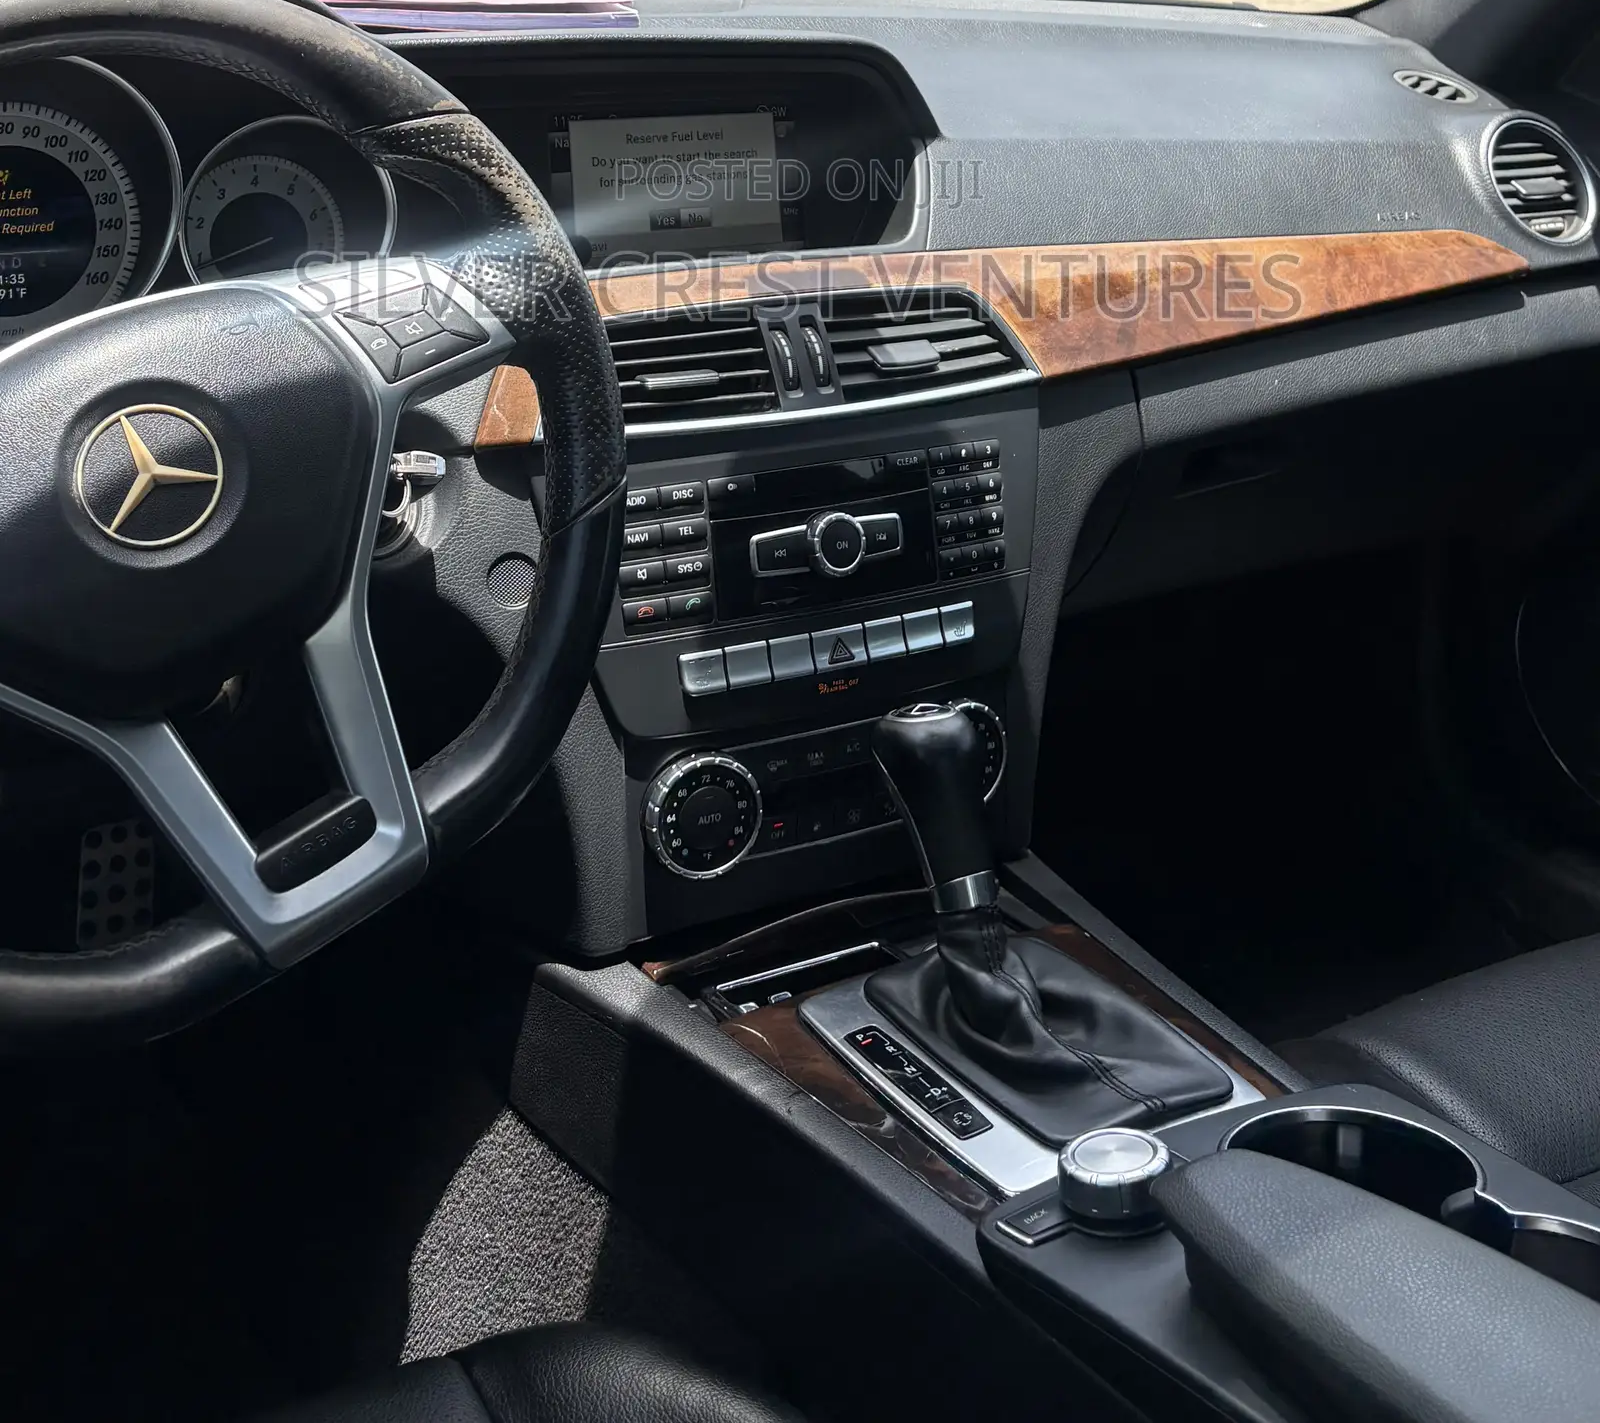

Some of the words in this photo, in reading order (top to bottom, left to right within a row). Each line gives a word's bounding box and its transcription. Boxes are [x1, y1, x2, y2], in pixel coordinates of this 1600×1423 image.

[22, 126, 40, 139] 90
[626, 133, 669, 145] Reserve
[671, 130, 693, 142] Fuel
[697, 129, 724, 140] Level
[44, 135, 68, 148] 100
[67, 150, 89, 163] 110
[592, 156, 606, 167] Do
[610, 155, 630, 170] you
[633, 155, 659, 166] want
[662, 153, 674, 164] to
[676, 151, 700, 163] start
[704, 149, 721, 160] the
[724, 148, 757, 159] search
[83, 169, 107, 182] 120
[599, 177, 615, 188] for
[685, 173, 703, 185] gas
[250, 176, 259, 187] 4
[9, 189, 32, 200] Left
[217, 189, 226, 200] 3
[287, 184, 295, 195] 5
[94, 192, 118, 206] 130
[310, 209, 317, 221] 6
[656, 214, 675, 225] Yes
[688, 212, 703, 223] No
[2, 221, 55, 235] Required
[98, 217, 123, 231] 140
[195, 217, 205, 229] 2
[95, 244, 120, 258] 150
[85, 271, 110, 286] 160
[986, 445, 991, 454] 3
[897, 457, 918, 466] CLEAR
[989, 478, 994, 488] 6
[673, 489, 694, 500] DISC
[626, 495, 647, 507] ADIO
[968, 516, 974, 525] 8
[991, 511, 997, 521] 9
[945, 520, 951, 530] 7
[678, 526, 694, 536] TEL
[627, 533, 649, 544] NAVI
[836, 541, 849, 550] ON
[972, 550, 977, 559] 0
[678, 562, 693, 574] SYS
[846, 742, 861, 753] A/C
[702, 775, 711, 783] 72
[725, 780, 735, 789] 76
[737, 800, 747, 809] 80
[666, 814, 676, 823] 64
[697, 813, 722, 826] AUTO
[671, 838, 682, 847] 60
[855, 1033, 864, 1042] P
[886, 1045, 896, 1053] R
[904, 1065, 917, 1074] N
[1023, 1208, 1048, 1225] BACK
